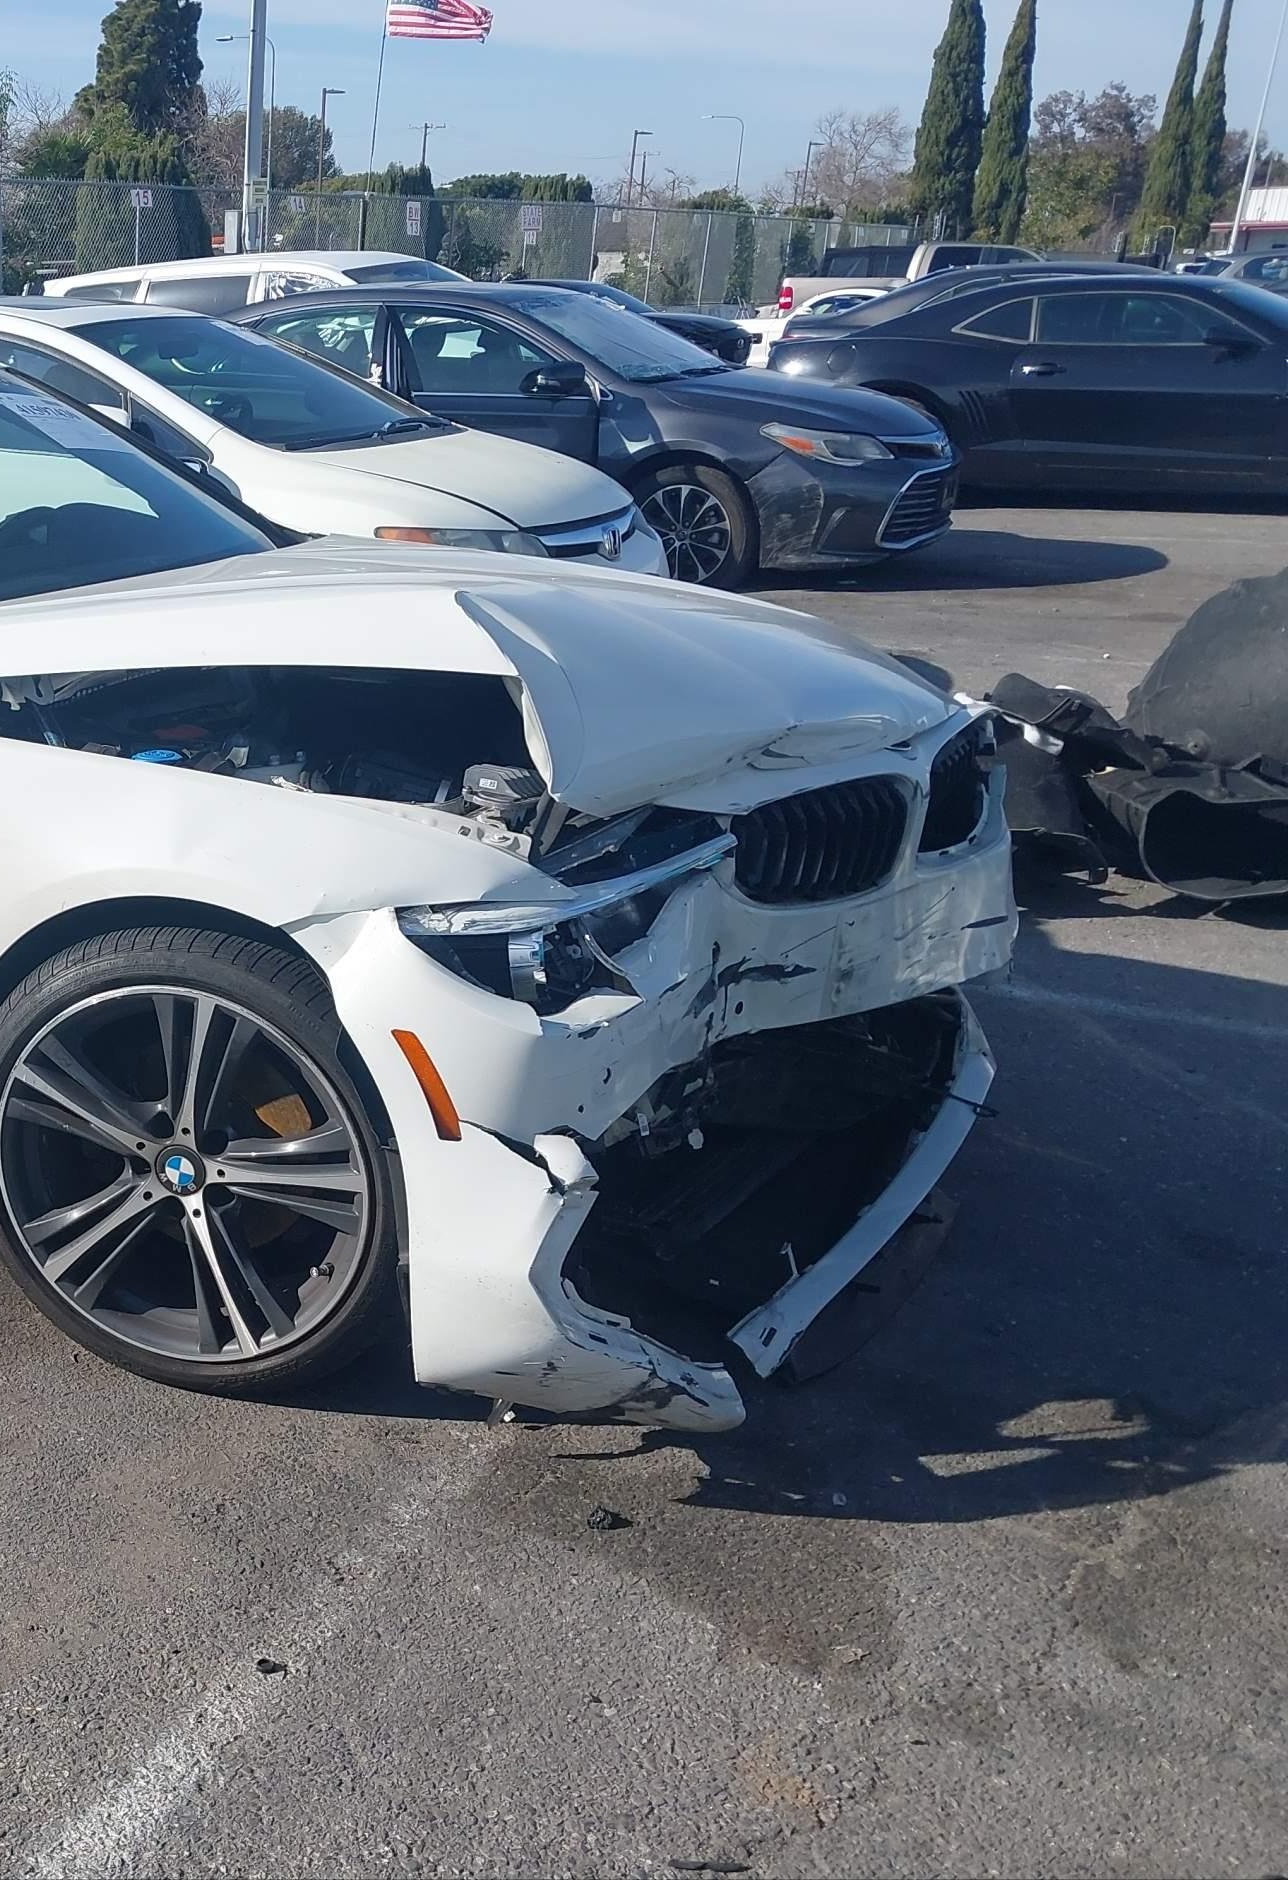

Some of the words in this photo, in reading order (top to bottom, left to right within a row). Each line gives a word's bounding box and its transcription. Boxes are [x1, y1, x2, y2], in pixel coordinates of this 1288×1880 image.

[135, 190, 149, 206] 15
[522, 206, 542, 216] STATE
[409, 221, 419, 234] 13
